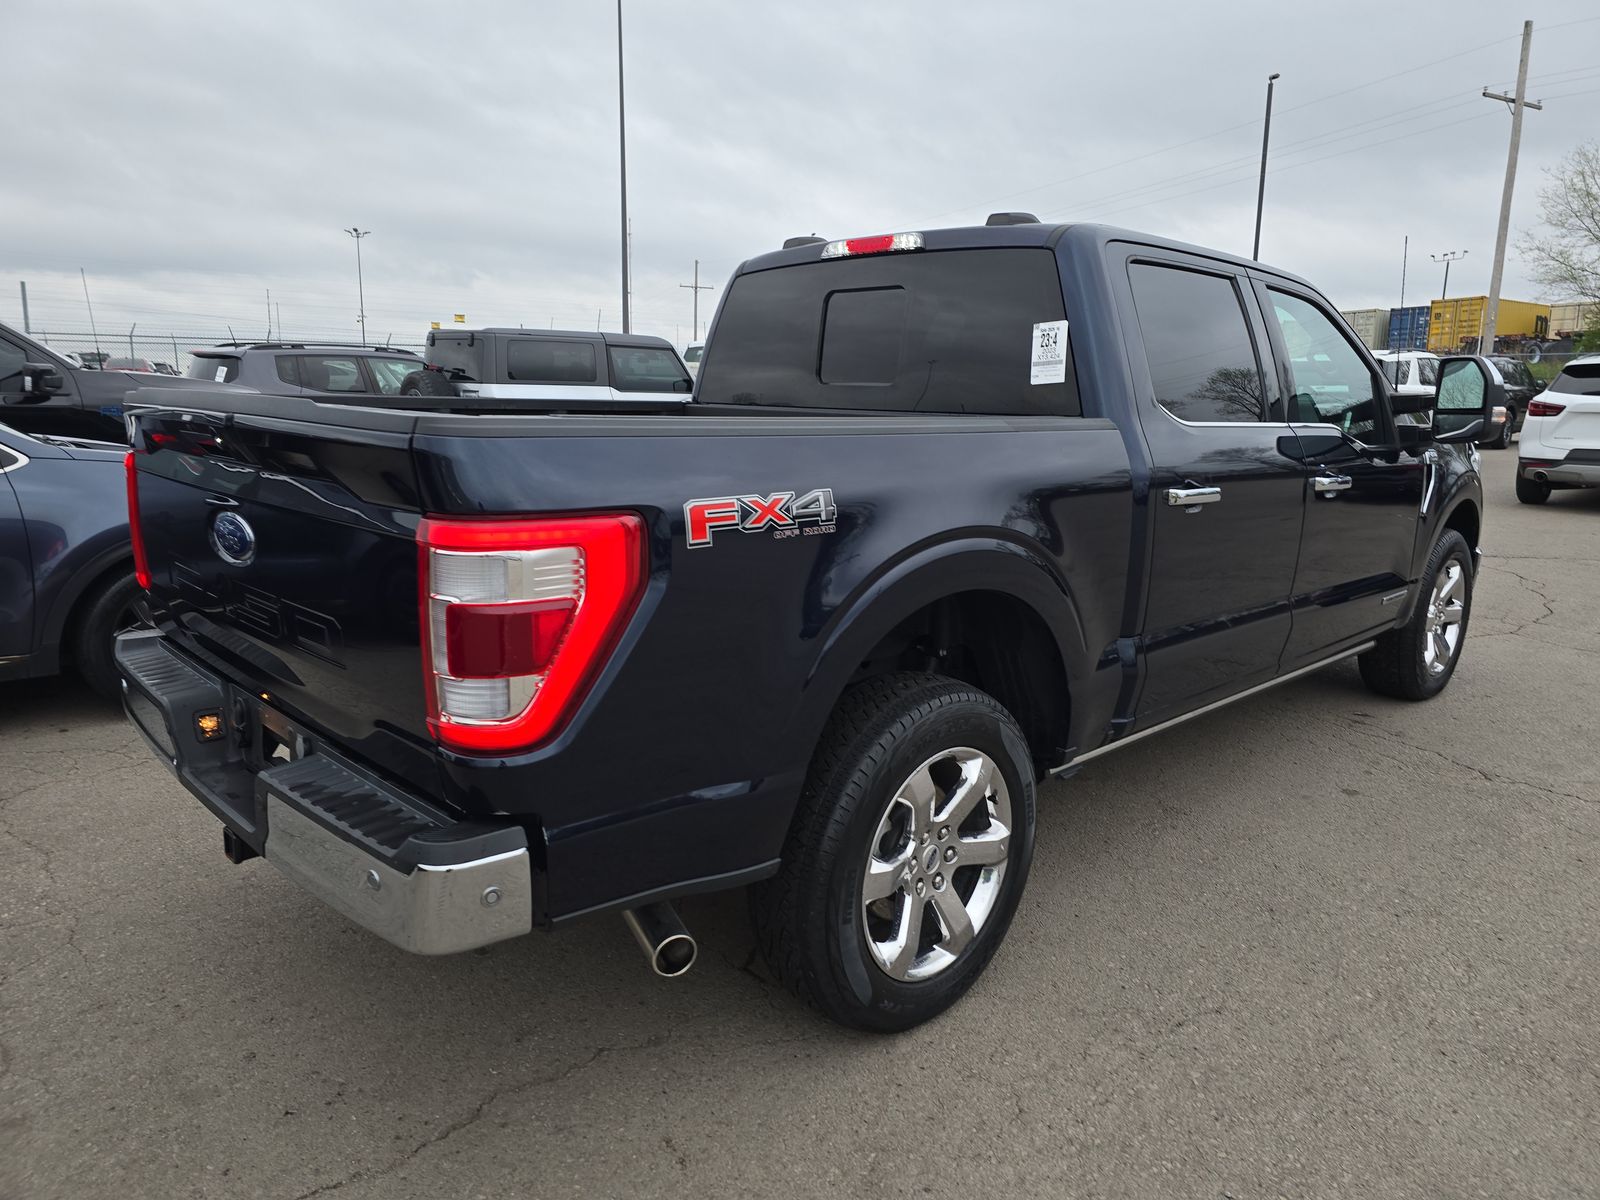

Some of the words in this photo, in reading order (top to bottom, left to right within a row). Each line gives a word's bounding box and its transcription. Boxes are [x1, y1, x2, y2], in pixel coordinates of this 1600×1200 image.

[1040, 332, 1058, 348] 23:4
[683, 488, 837, 549] FX4
[773, 528, 799, 539] OFF
[803, 524, 836, 536] ROAD
